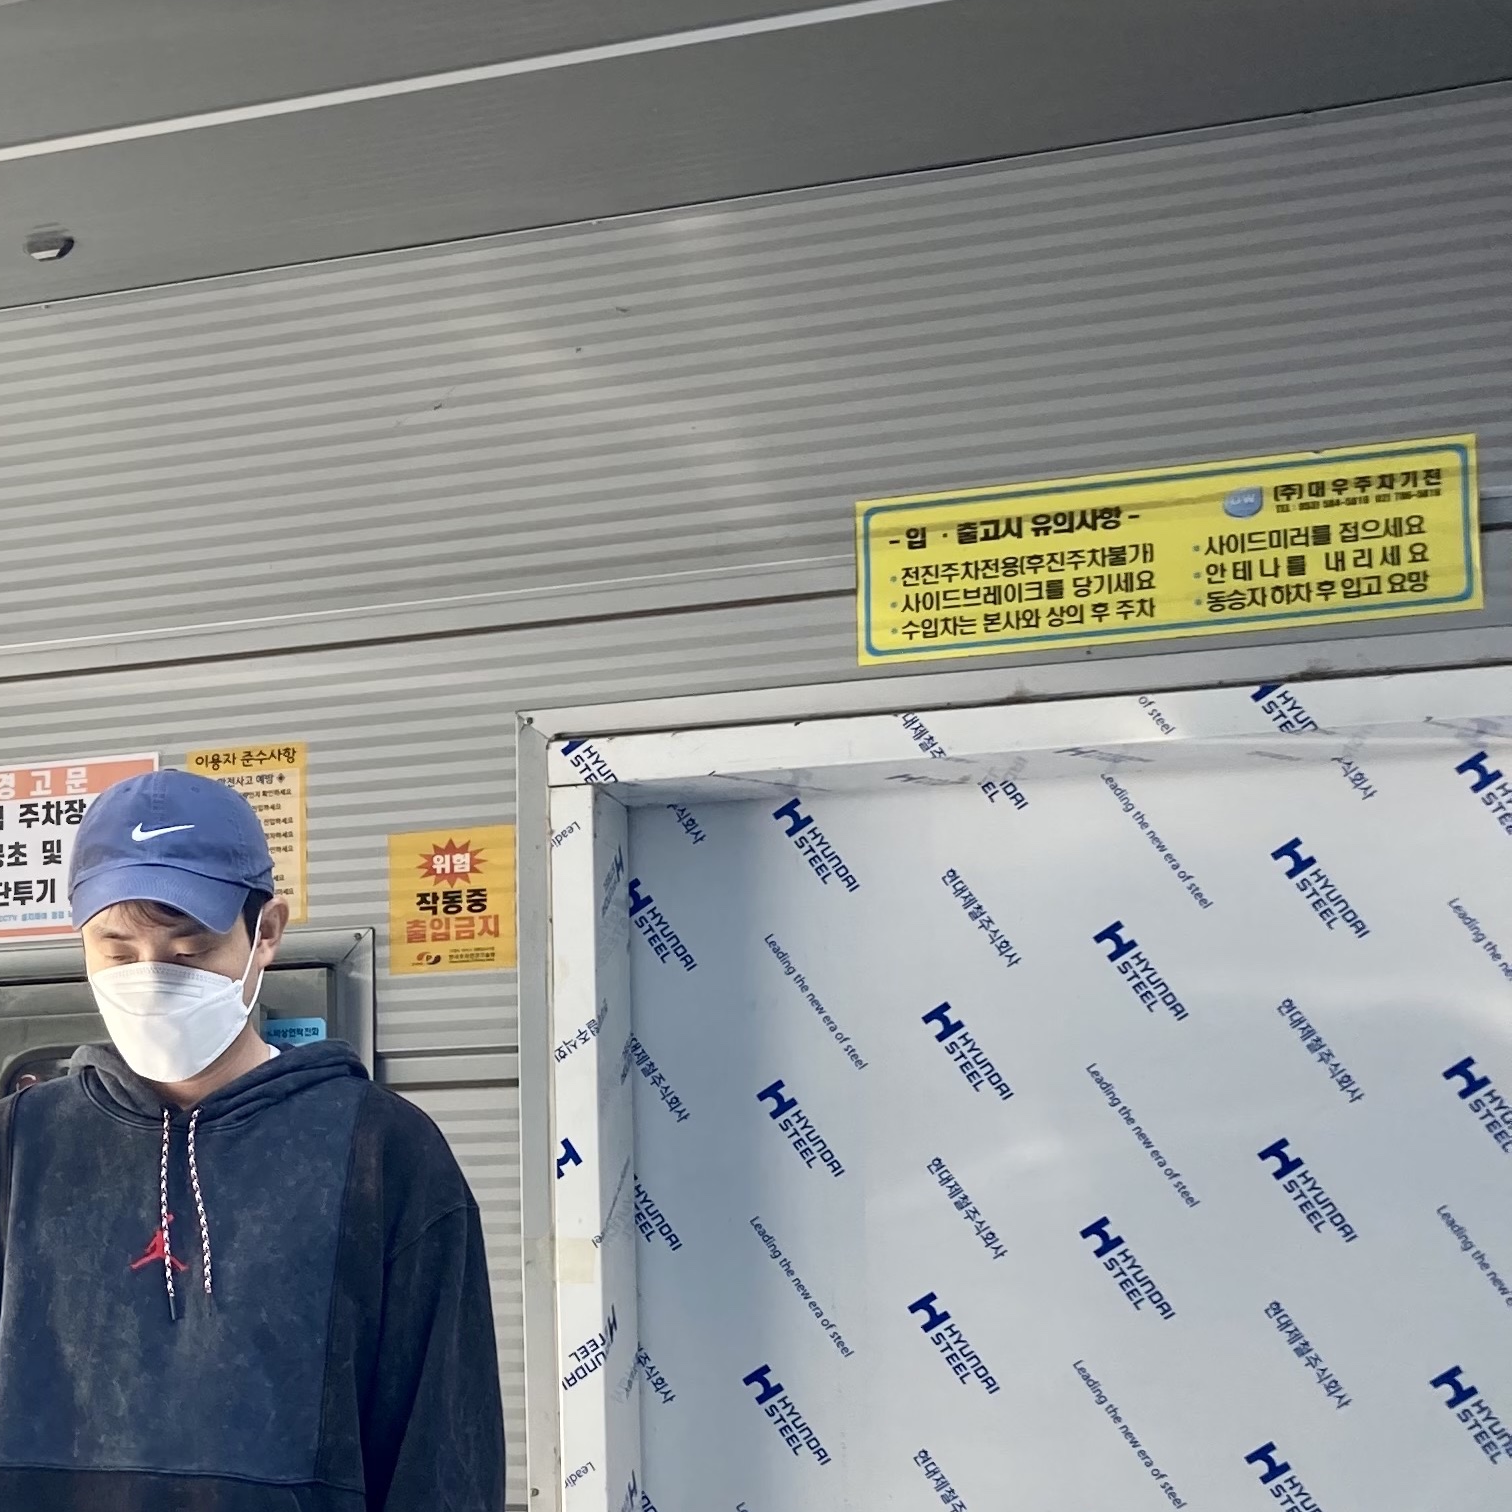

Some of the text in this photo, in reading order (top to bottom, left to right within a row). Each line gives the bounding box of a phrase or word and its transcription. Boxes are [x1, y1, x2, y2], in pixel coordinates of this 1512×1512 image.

[905, 506, 1122, 550] 입 출고시 유의사항
[1204, 514, 1426, 556] 사이드미러를 접으세요
[1206, 542, 1430, 585] 안테나를 내리세요
[901, 570, 1156, 614] 사이드브레이크를 당기세요
[1206, 570, 1430, 613] 동승자 하차 후 입고 요망
[901, 598, 1155, 641] 수입차는 본사와 상의 후 주차
[195, 747, 297, 771] 이용자 준수사항
[256, 774, 274, 785] 예방
[18, 799, 86, 828] 주차장
[42, 839, 62, 866] 및
[432, 852, 471, 874] 위험
[795, 836, 831, 884] STEEL
[807, 827, 860, 892] HYUNDAI
[416, 888, 488, 916] 작동중
[942, 868, 1021, 967] 현대제철주식회사
[1296, 878, 1337, 930] STEEL
[1310, 868, 1370, 938] HYUNDAI
[406, 914, 500, 944] 출입금지
[634, 916, 669, 963] STEEL
[646, 906, 697, 971] HYUNDAI
[765, 934, 868, 1070] Leading the new era of steel
[1117, 961, 1157, 1012] STEEL
[1131, 952, 1188, 1021] HYUNDAI
[945, 1041, 983, 1092] STEEL
[958, 1032, 1014, 1100] HYUNDAI
[1277, 998, 1364, 1103] 현대제철주식회사
[779, 1119, 815, 1168] STEEL
[791, 1110, 844, 1177] HYUNDAI
[1086, 1063, 1200, 1207] Leading the new era of steel
[927, 1157, 1007, 1259] 현대제철주식회사
[1283, 1180, 1324, 1233] STEEL
[1297, 1170, 1358, 1242] HYUNDAI
[750, 1216, 854, 1357] Leading the new era of steel
[1103, 1258, 1143, 1310] STEEL
[1117, 1249, 1175, 1319] HYUNDAI
[931, 1333, 969, 1384] STEEL
[941, 1324, 1000, 1394] HYUNDAI
[1264, 1301, 1352, 1408] 현대제철주식회사
[765, 1405, 801, 1456] STEEL
[774, 1396, 831, 1465] HYUNDAI
[1073, 1360, 1187, 1509] Leading the new era of steel
